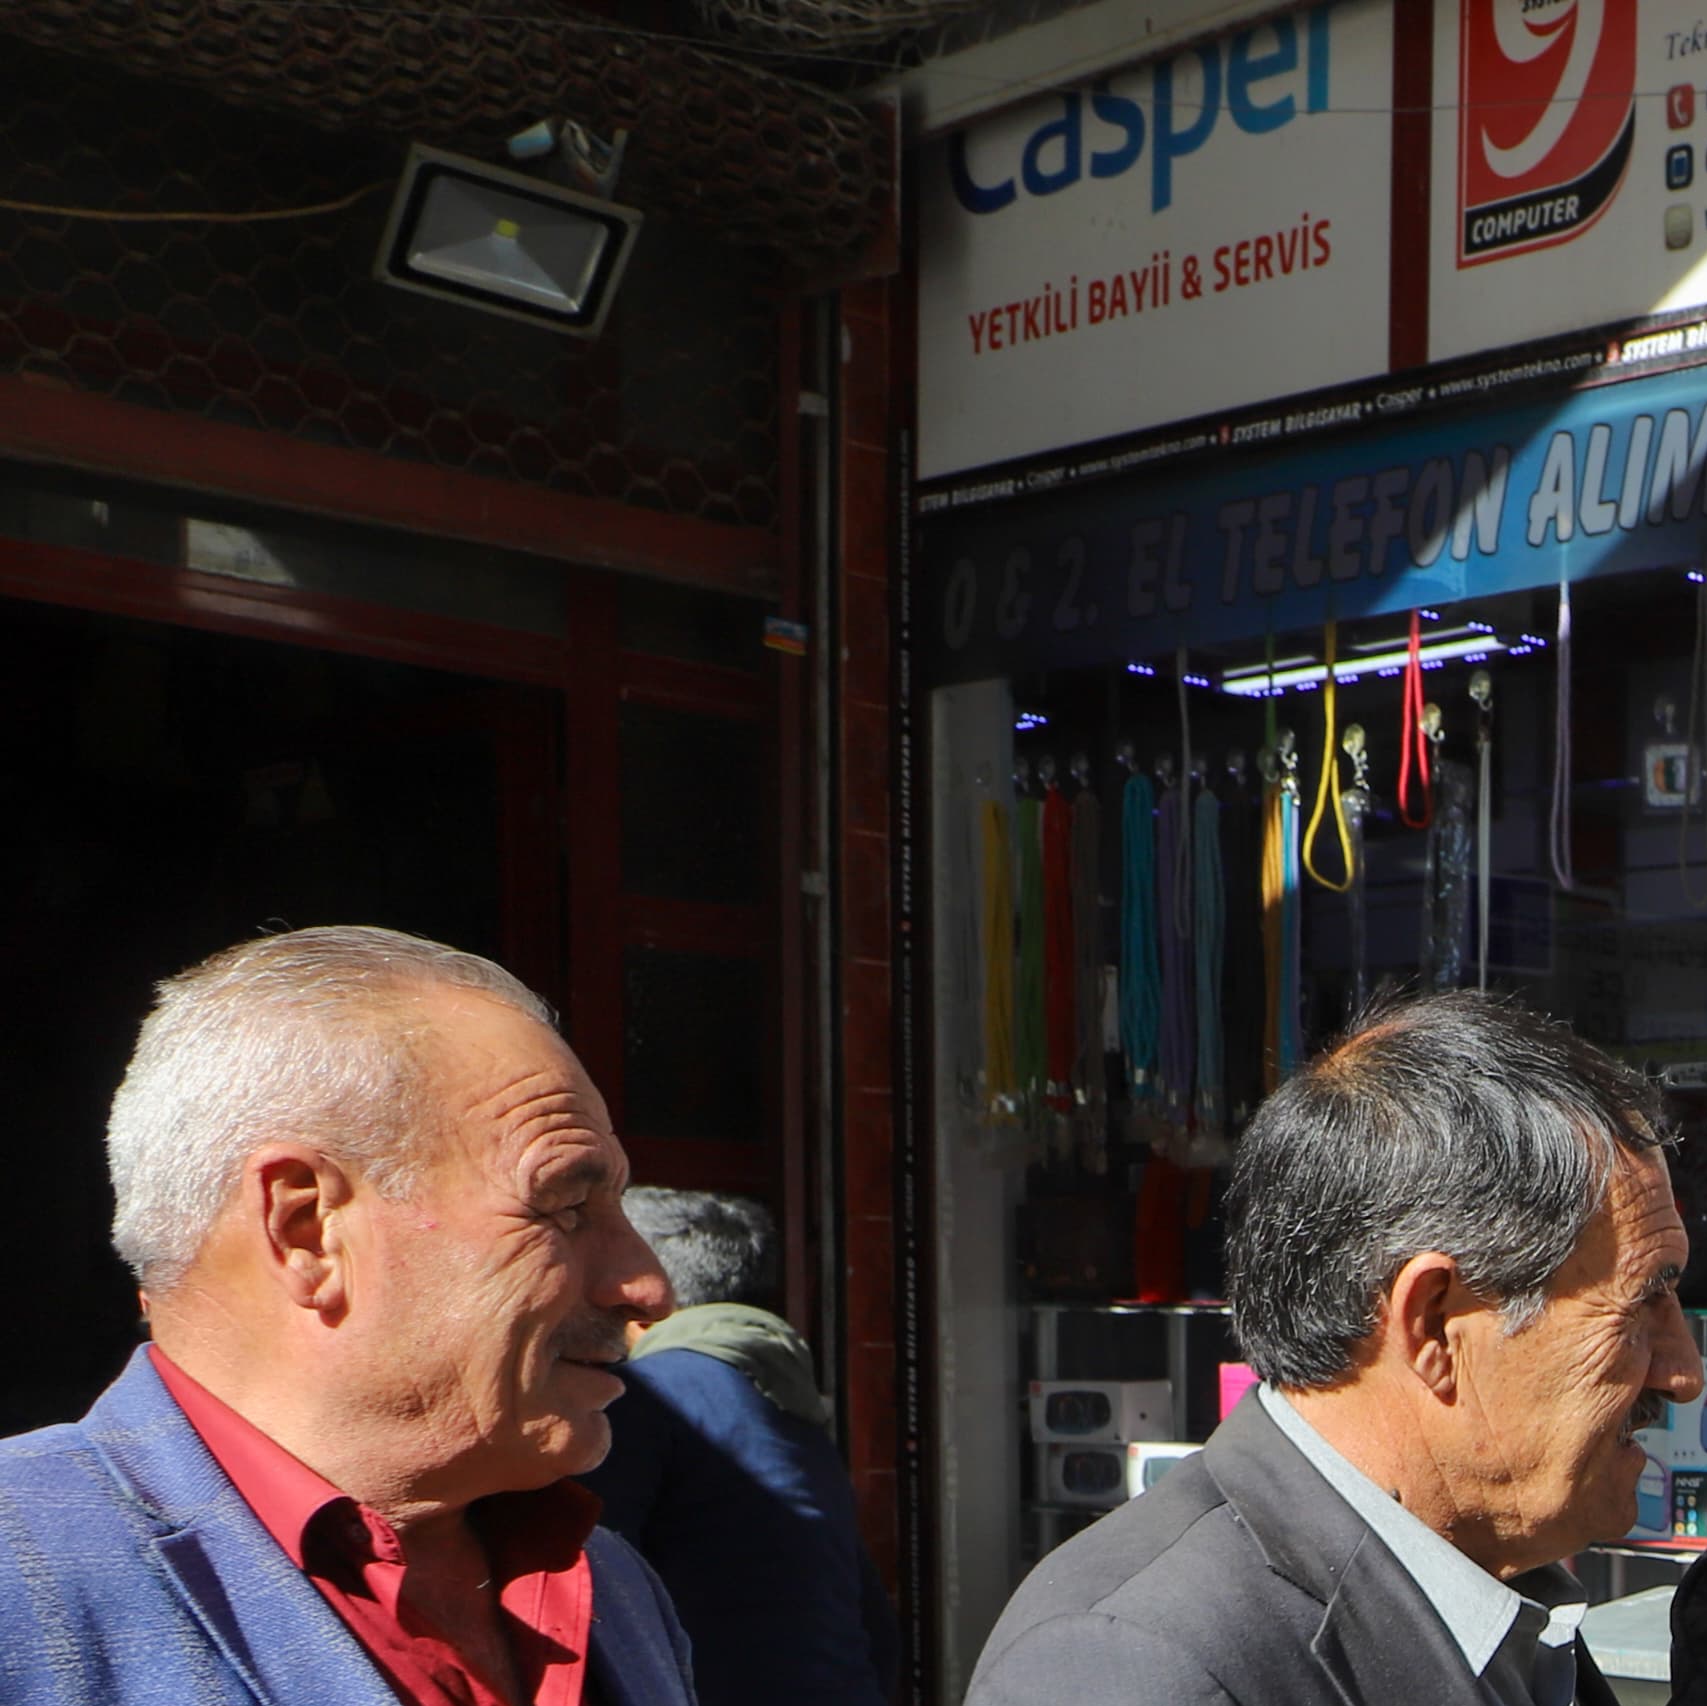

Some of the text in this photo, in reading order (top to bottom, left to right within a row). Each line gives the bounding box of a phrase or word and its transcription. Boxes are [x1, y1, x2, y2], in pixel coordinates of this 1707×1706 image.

[1471, 195, 1580, 246] COMPUTER
[968, 275, 1079, 356] YETKİLİ
[1180, 255, 1203, 301] &
[1212, 211, 1332, 293] SERVİS
[1620, 325, 1684, 364] SYSTEM
[1126, 510, 1193, 618] EL
[1216, 444, 1509, 608] TELEFON
